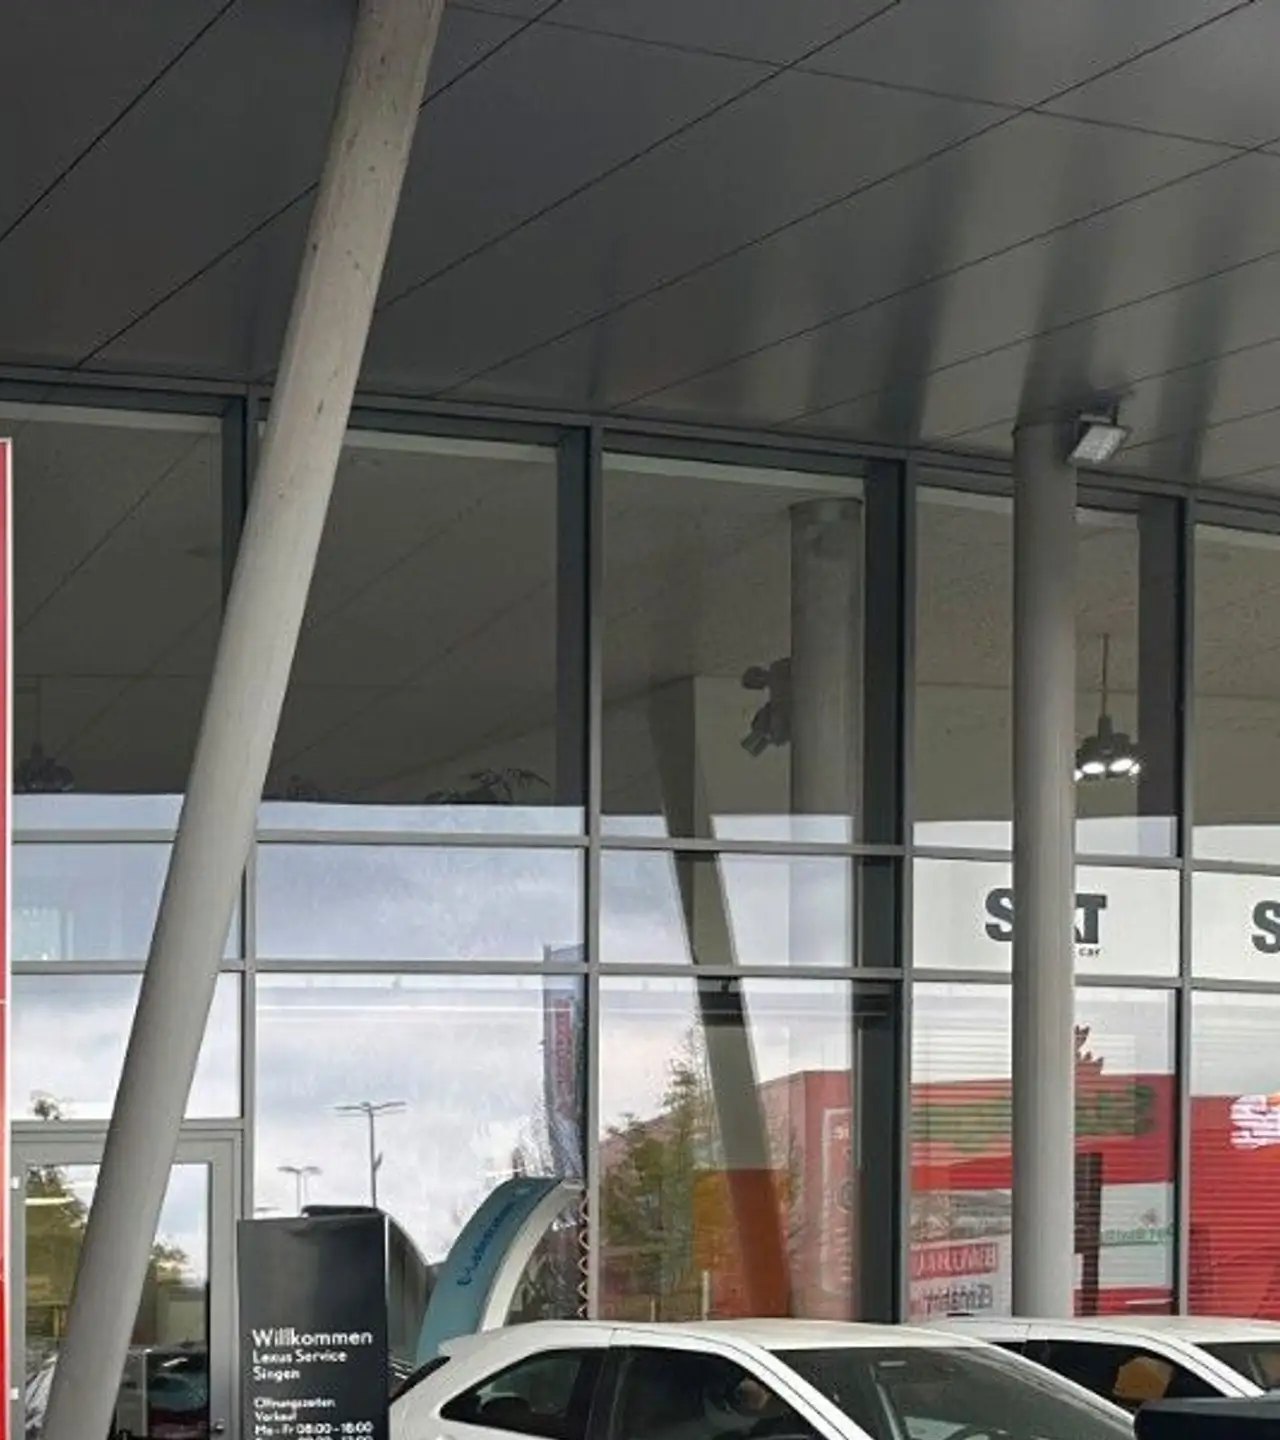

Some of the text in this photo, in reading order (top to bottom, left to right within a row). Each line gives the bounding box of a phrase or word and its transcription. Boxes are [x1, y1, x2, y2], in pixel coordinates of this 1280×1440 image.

[252, 1327, 373, 1347] Willkommen
[252, 1348, 347, 1364] Lexus Service
[252, 1366, 300, 1382] Singen
